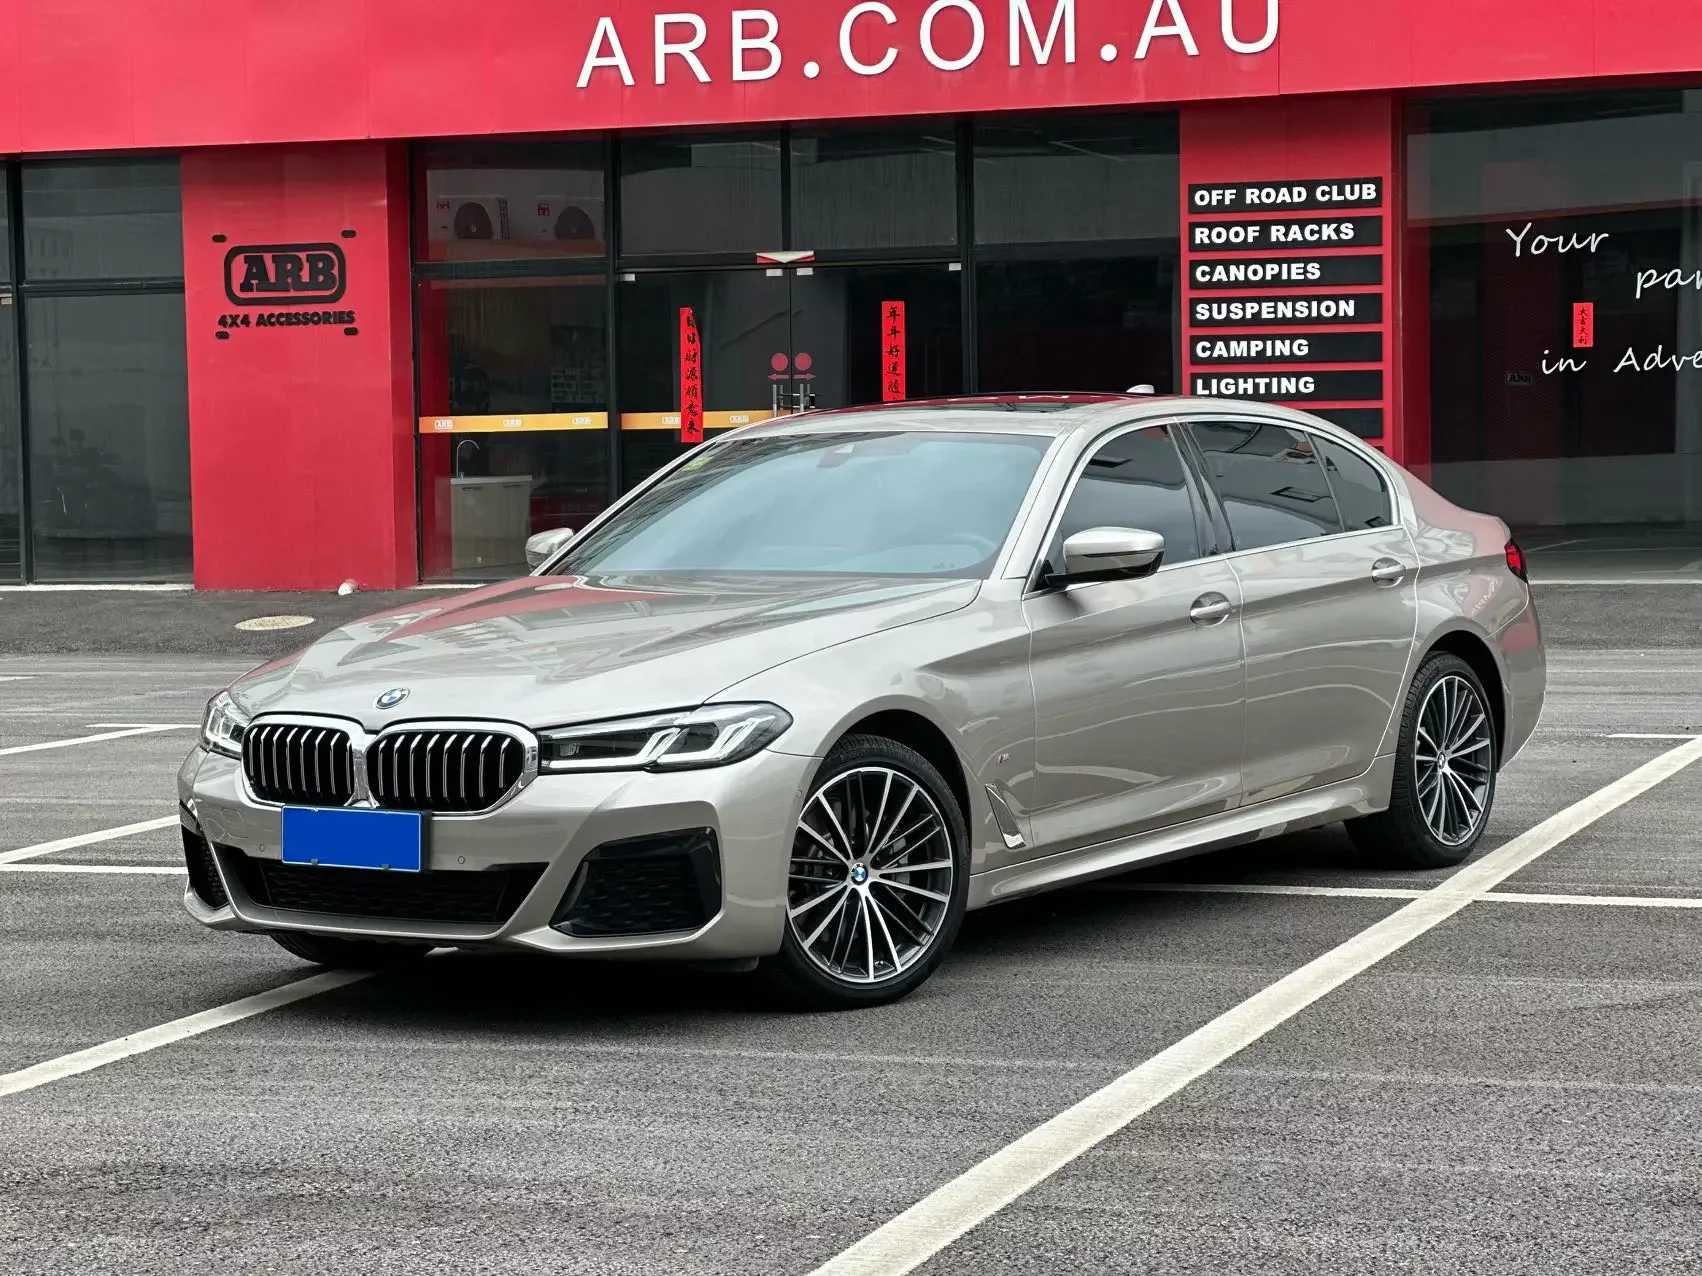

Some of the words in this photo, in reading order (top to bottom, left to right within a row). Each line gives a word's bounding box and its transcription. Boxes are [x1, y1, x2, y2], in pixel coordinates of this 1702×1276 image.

[576, 0, 1279, 88] ARB.COM.AU
[1194, 190, 1237, 206] OFF
[1245, 186, 1307, 204] ROAD
[1315, 183, 1377, 201] CLUB
[1195, 226, 1260, 244] ROOF
[1270, 222, 1355, 242] RACKS
[1505, 222, 1610, 257] Your
[239, 253, 337, 292] ARB
[1195, 263, 1321, 282] CANOPIES
[218, 314, 251, 328] 4X4
[256, 310, 356, 328] ACCESSORIES
[1195, 299, 1356, 320] SUSPENSION
[1576, 305, 1589, 345] 大吉大利
[1195, 339, 1310, 358] CAMPING
[1541, 350, 1587, 375] in
[1196, 376, 1315, 395] LIGHTING
